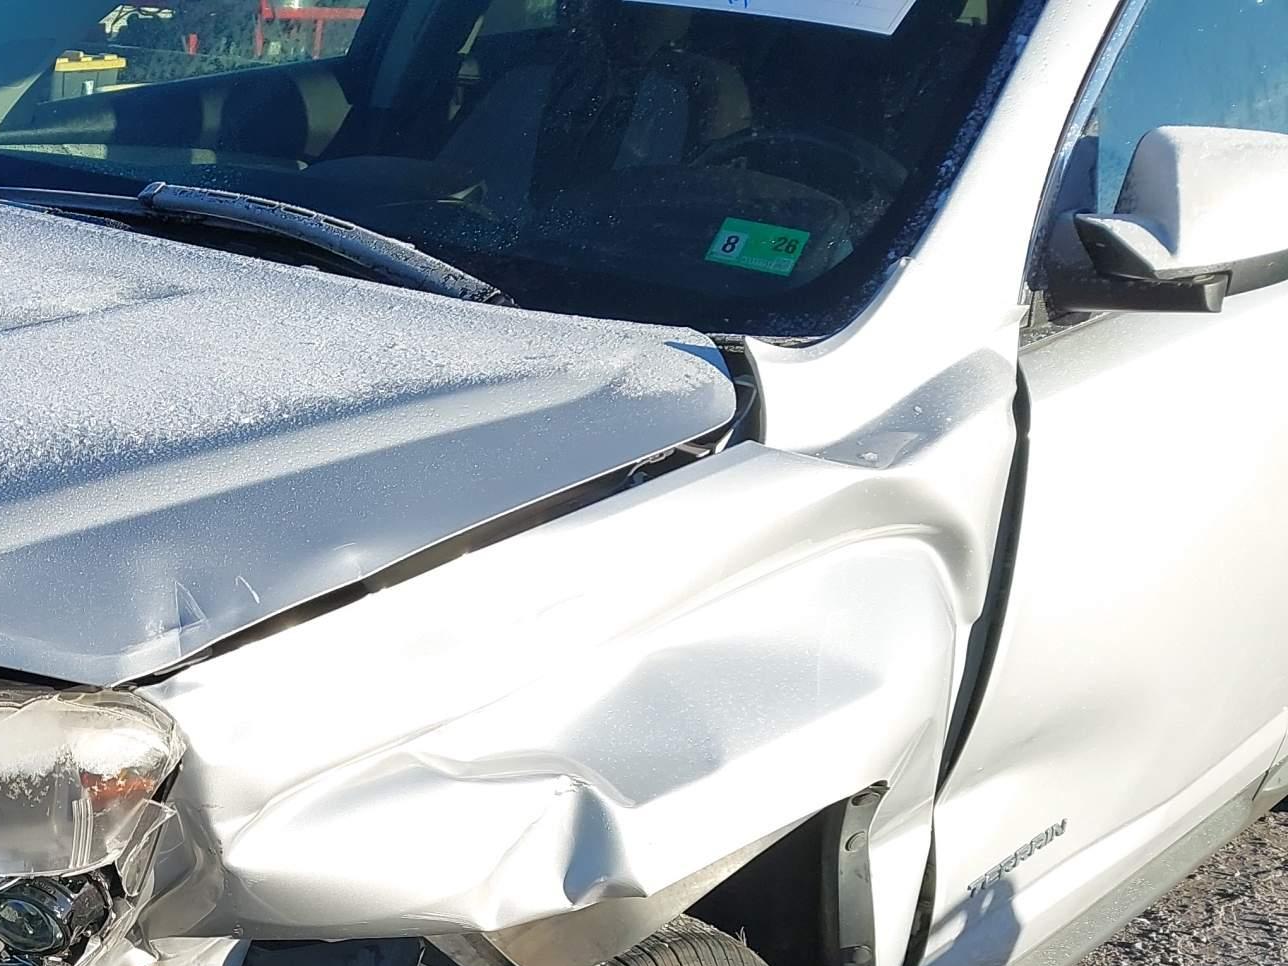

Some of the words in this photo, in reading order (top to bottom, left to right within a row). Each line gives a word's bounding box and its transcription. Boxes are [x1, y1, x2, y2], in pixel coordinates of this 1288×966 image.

[721, 235, 740, 253] 8
[772, 236, 799, 254] 26
[967, 818, 1067, 898] TERRAIN
